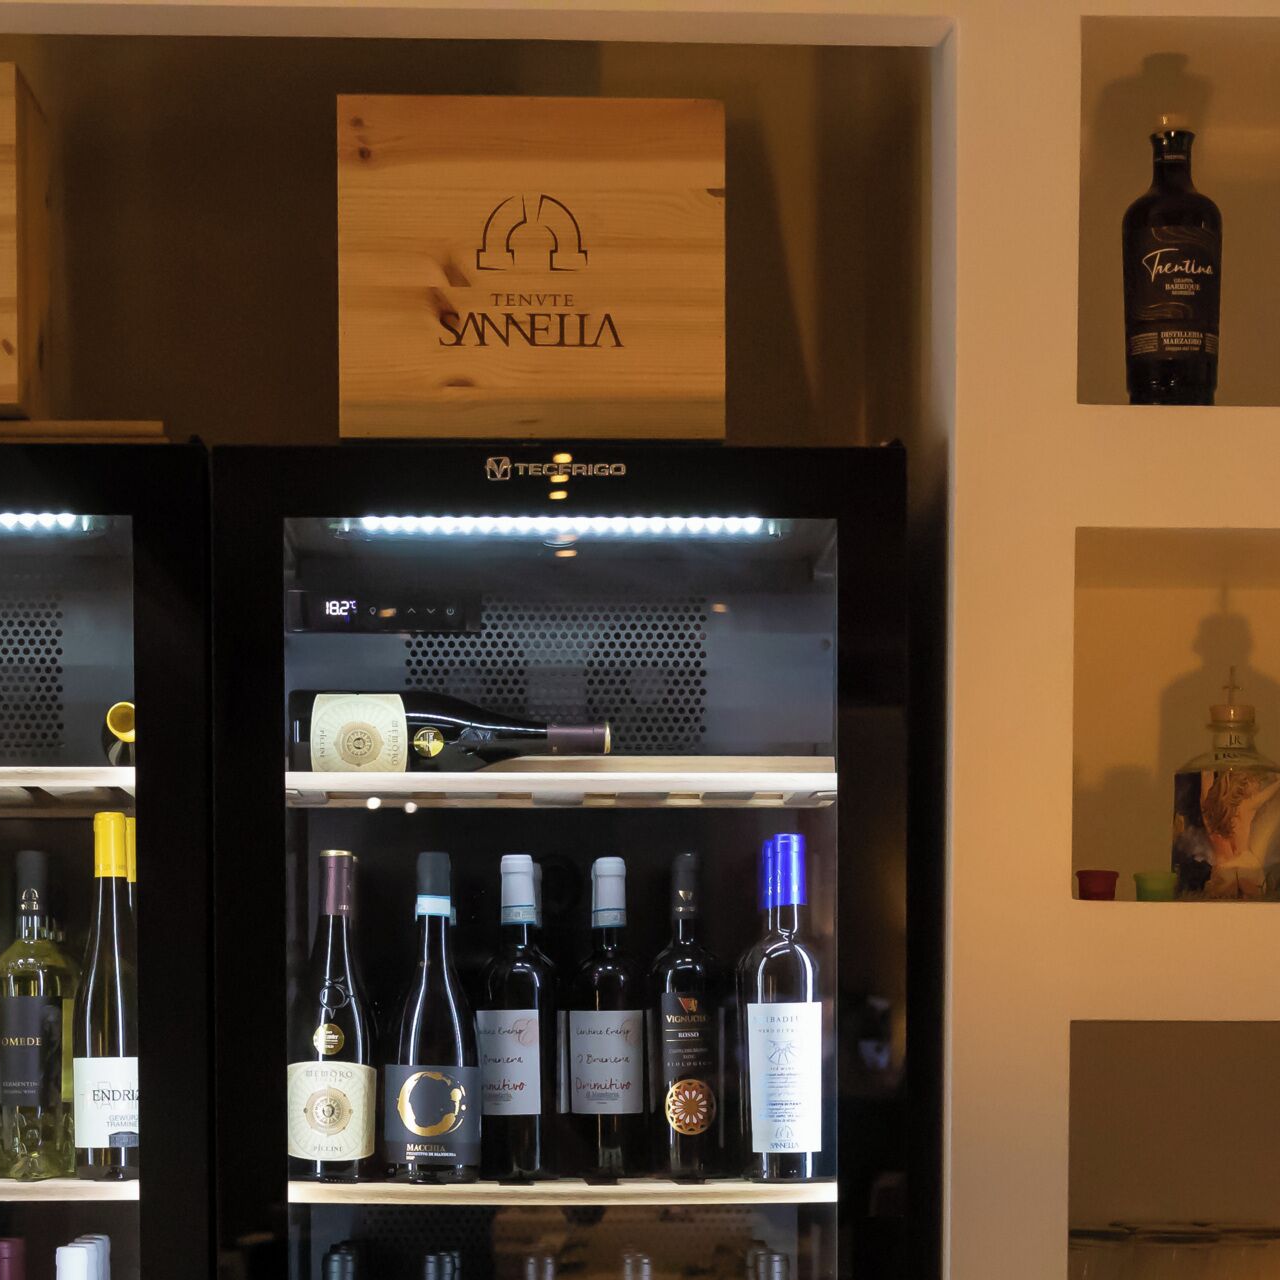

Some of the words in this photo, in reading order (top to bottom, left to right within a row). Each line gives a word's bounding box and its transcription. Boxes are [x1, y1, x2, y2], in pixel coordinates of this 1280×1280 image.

[1142, 247, 1214, 284] Trentino
[490, 293, 576, 308] TENVTE
[438, 311, 625, 349] SANNELLA
[514, 462, 627, 477] TECFRIGO
[678, 1031, 700, 1039] ROSSO
[406, 1143, 447, 1152] MACCHIA
